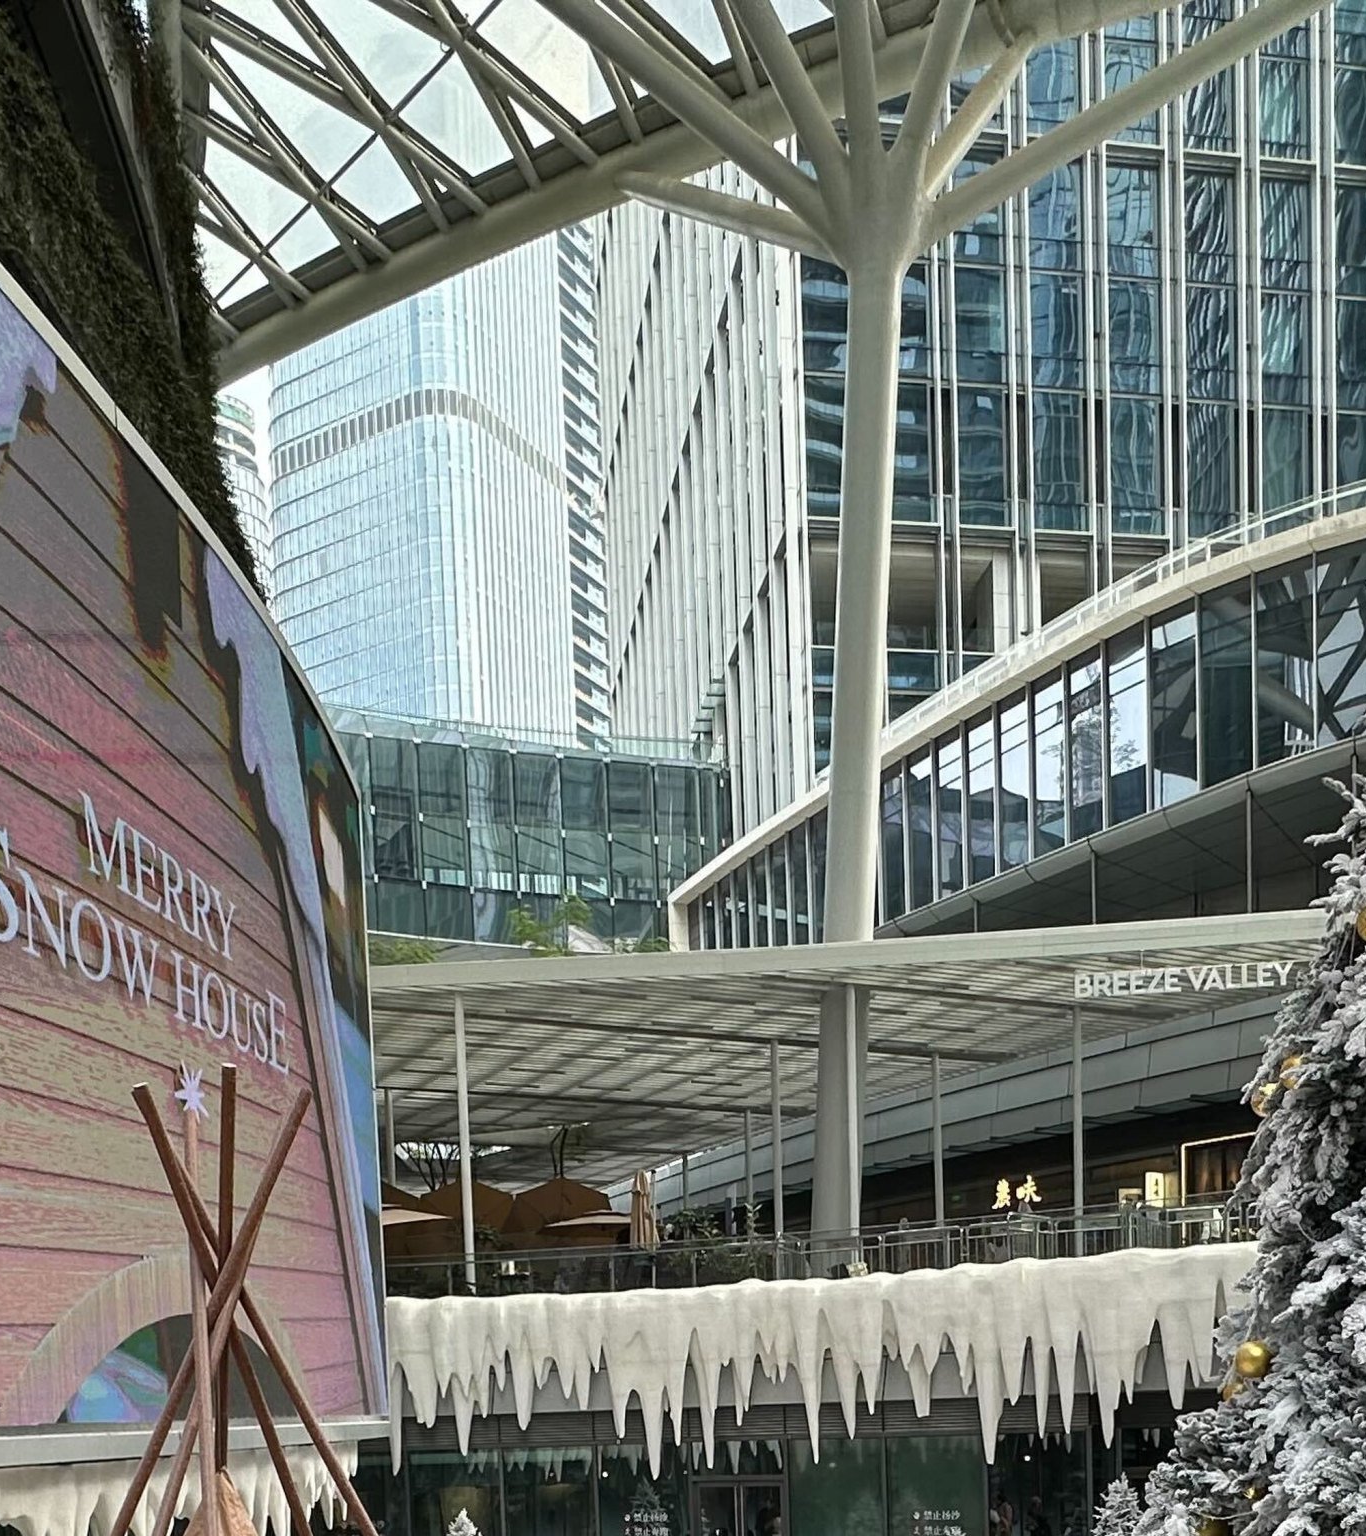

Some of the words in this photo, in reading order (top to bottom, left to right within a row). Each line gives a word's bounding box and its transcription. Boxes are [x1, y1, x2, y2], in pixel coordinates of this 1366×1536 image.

[78, 789, 238, 962] MERRY
[170, 948, 291, 1076] HOUSE
[1074, 967, 1183, 999] BREEZE
[1188, 960, 1296, 991] VALLEY
